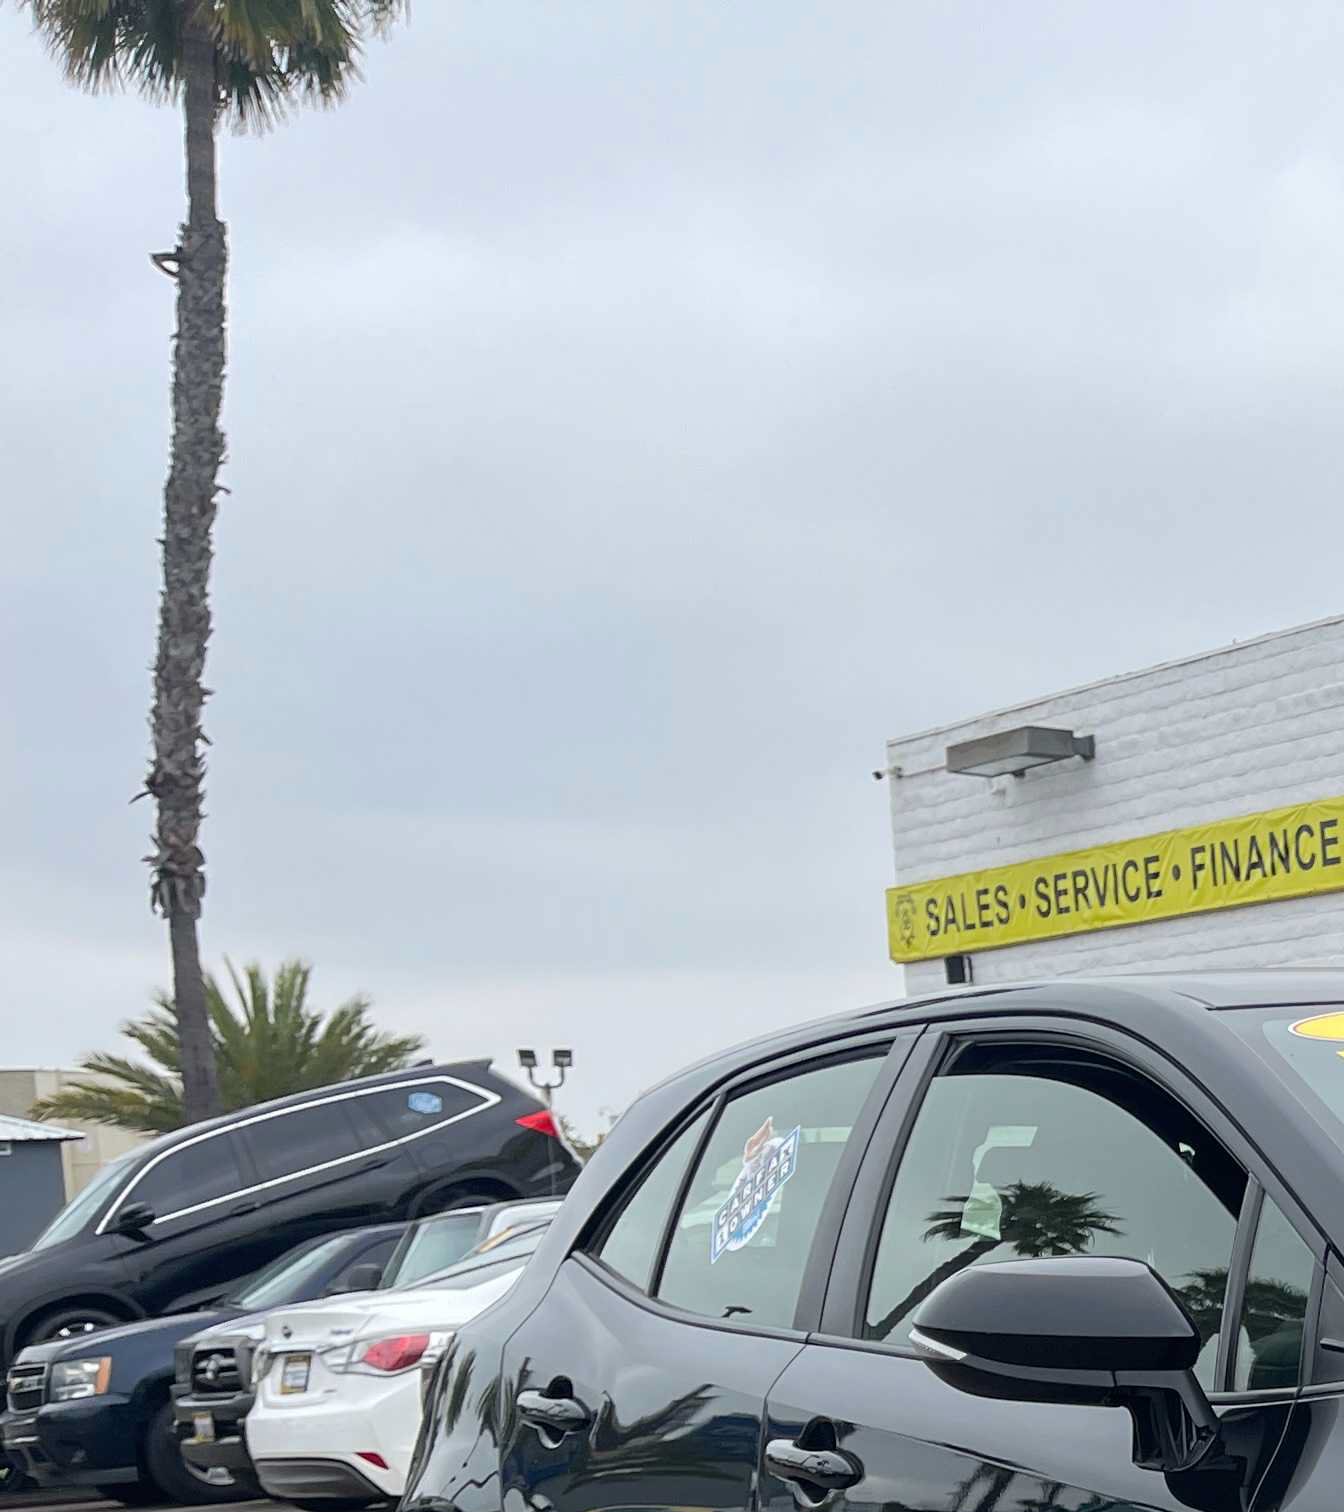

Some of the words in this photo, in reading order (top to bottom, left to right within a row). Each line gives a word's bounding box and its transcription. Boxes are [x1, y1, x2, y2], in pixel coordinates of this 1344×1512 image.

[925, 884, 1011, 937] SALES
[1036, 855, 1163, 919] SERVICE
[1191, 818, 1341, 891] FINANCE
[718, 1133, 794, 1227] CARFAX
[729, 1162, 789, 1232] OWNER
